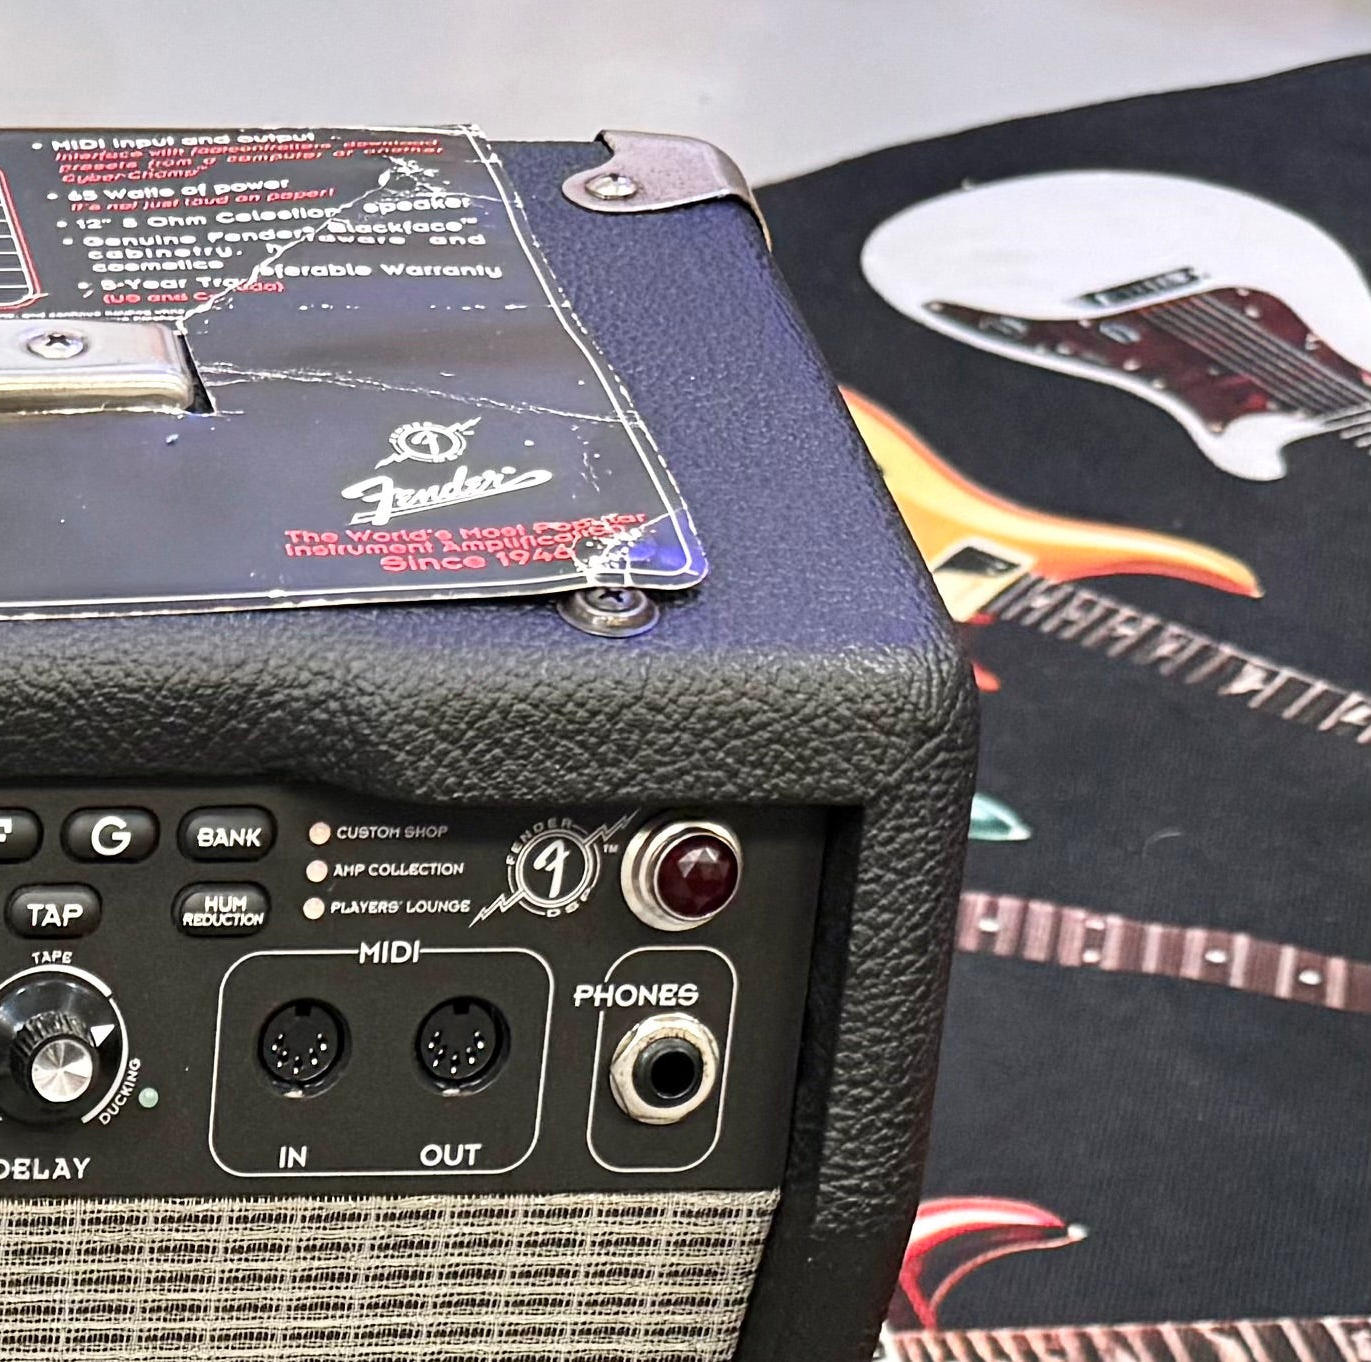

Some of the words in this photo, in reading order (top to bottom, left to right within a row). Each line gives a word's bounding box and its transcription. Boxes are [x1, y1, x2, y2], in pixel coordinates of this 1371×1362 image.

[52, 138, 105, 151] MIDI
[182, 135, 230, 146] and
[341, 465, 552, 526] Fender
[91, 816, 132, 857] G
[197, 827, 262, 850] BANK
[336, 825, 400, 840] CUSTOM
[404, 825, 448, 839] SHOP
[506, 817, 573, 866] FENDER
[333, 863, 362, 877] AMP
[368, 862, 464, 877] COLLECTION
[27, 902, 84, 928] TAP
[204, 895, 247, 913] HUM
[406, 899, 471, 914] LOUNGE
[182, 912, 264, 928] REDUCTION
[31, 951, 73, 966] TAPE
[359, 940, 422, 965] MIDI
[573, 983, 699, 1008] PHONES
[98, 1057, 141, 1126] DUCKING
[278, 1145, 308, 1169] IN
[420, 1143, 482, 1168] OUT
